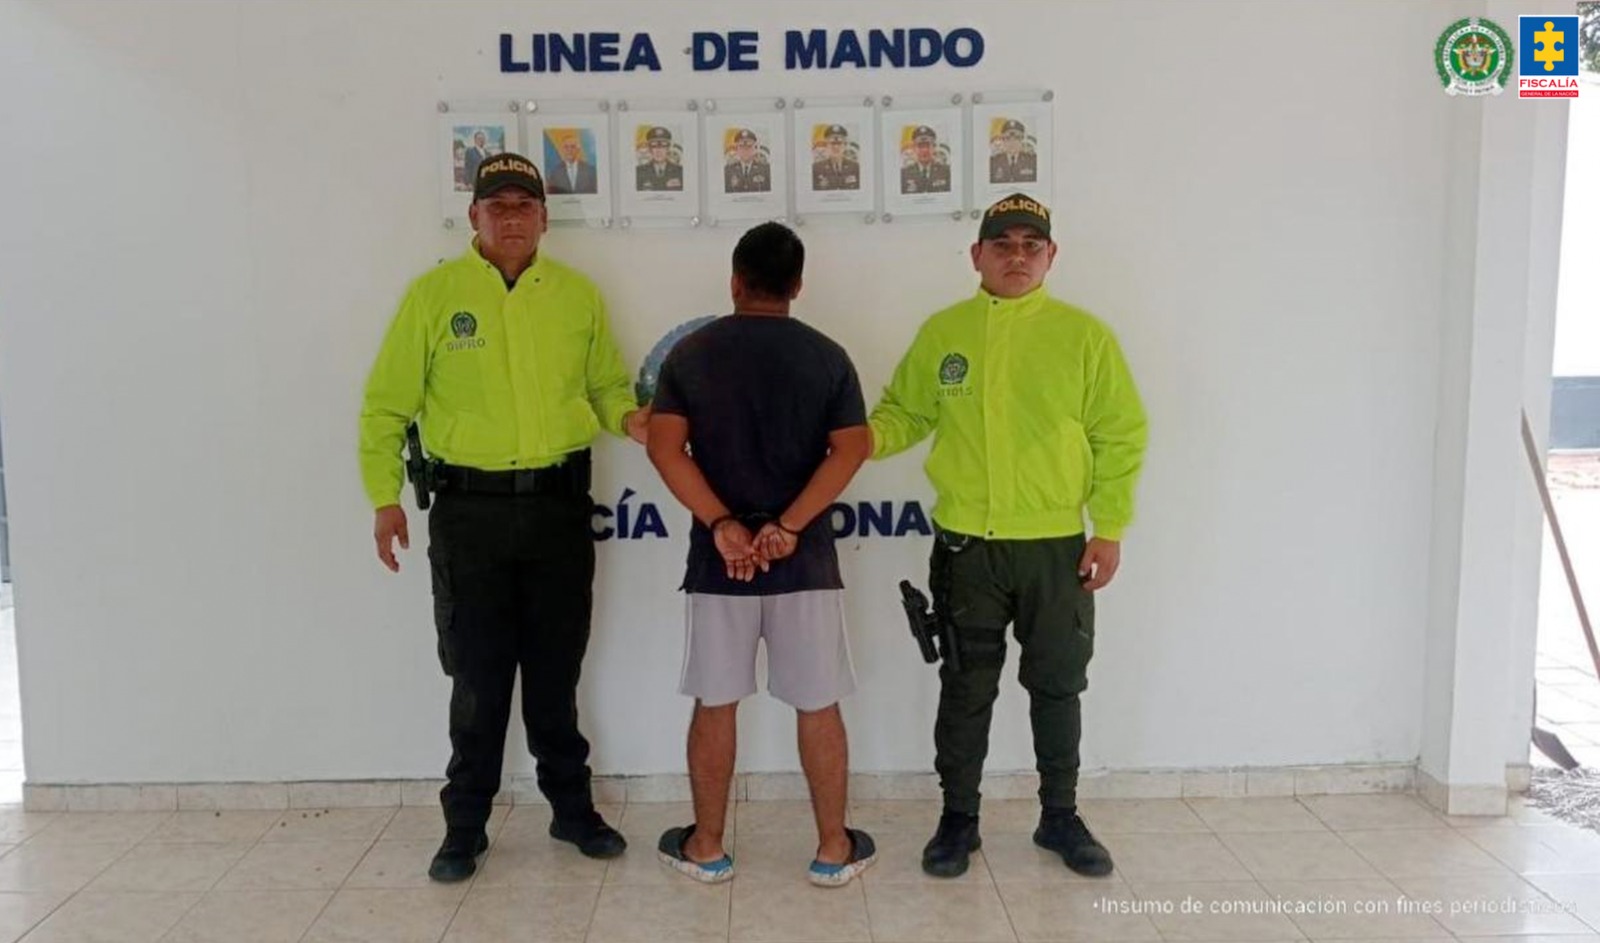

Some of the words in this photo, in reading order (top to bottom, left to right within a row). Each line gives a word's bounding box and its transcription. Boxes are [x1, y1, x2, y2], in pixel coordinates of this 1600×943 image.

[500, 33, 661, 72] LINEA
[692, 32, 760, 72] DE
[785, 28, 985, 70] MANDO
[480, 159, 538, 180] POLICIA
[989, 199, 1048, 220] POLICIA
